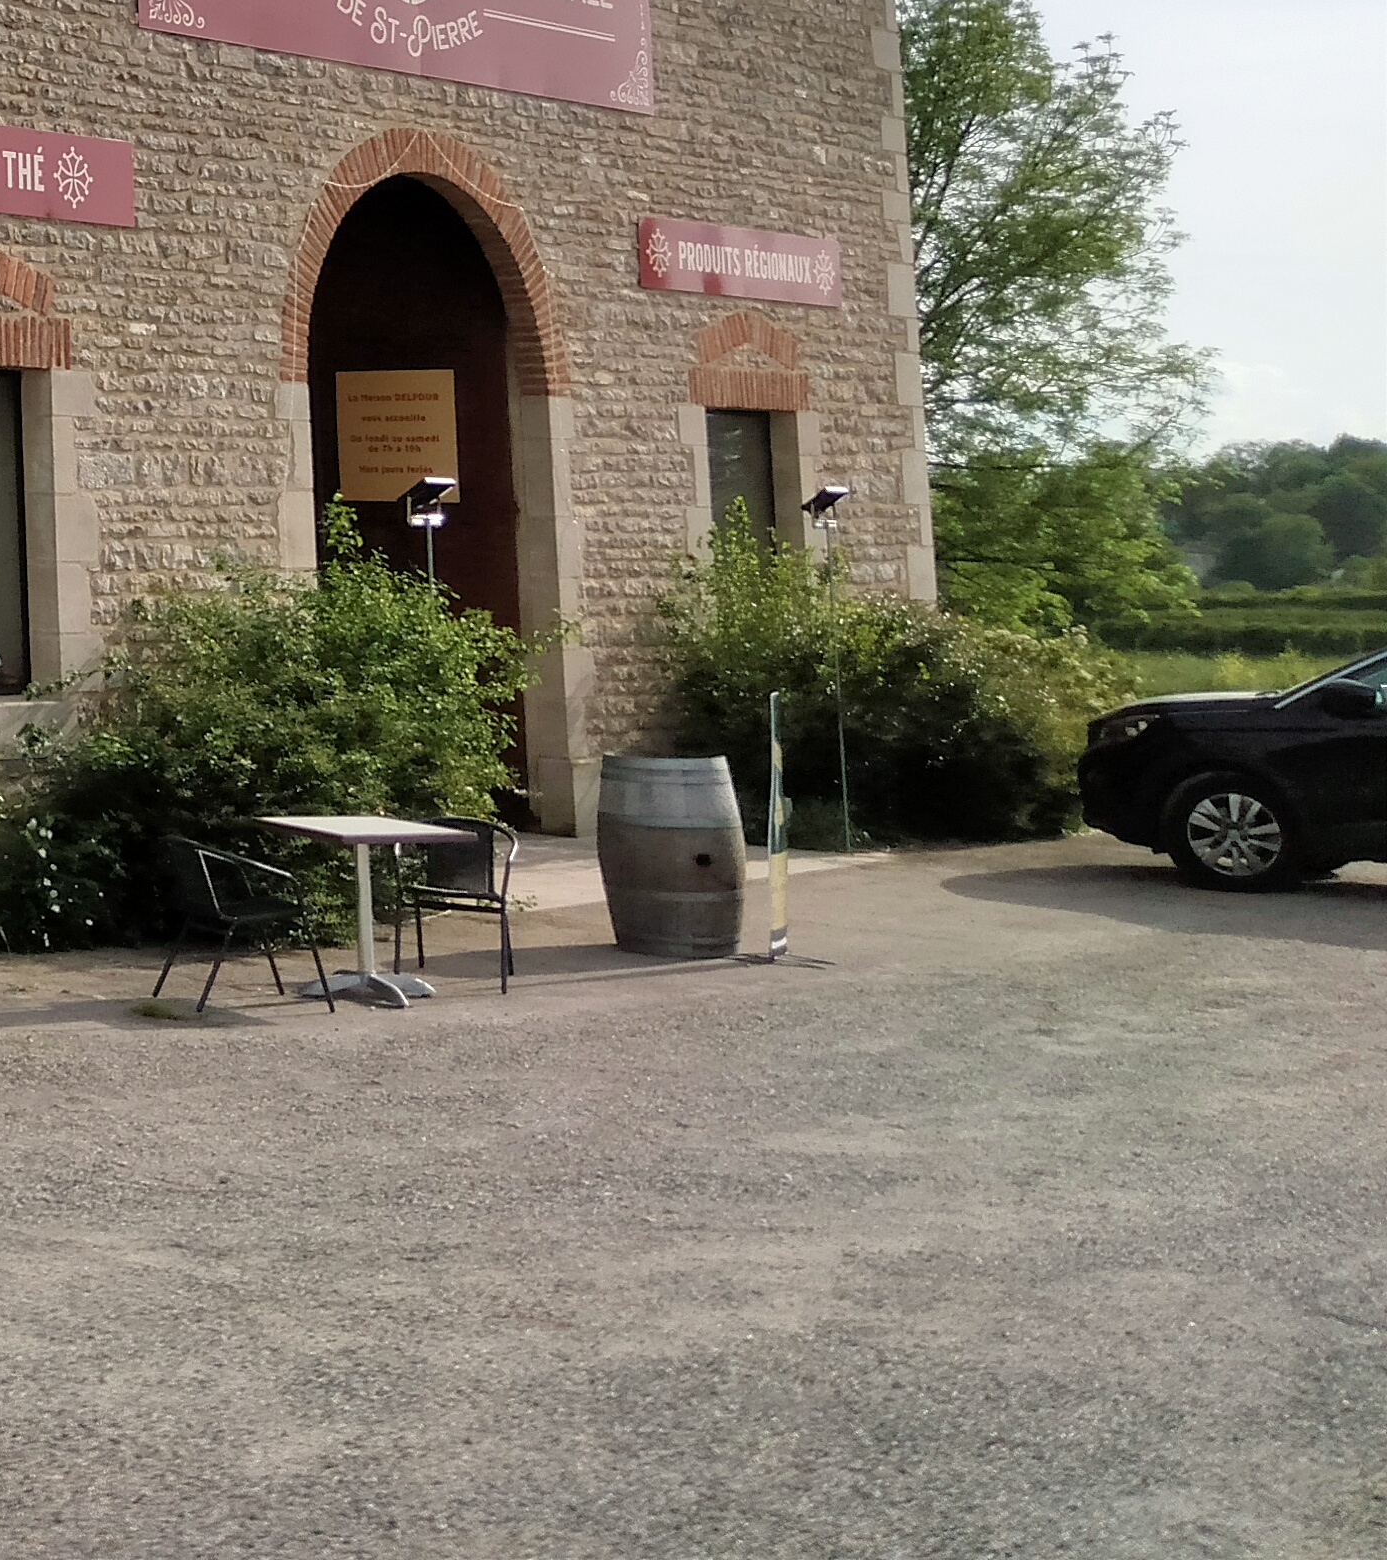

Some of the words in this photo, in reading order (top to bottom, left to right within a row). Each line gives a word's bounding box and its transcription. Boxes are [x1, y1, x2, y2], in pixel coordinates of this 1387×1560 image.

[2, 146, 45, 192] THÉ
[678, 241, 741, 276] PRODUITS
[744, 244, 812, 284] RÉGIONAUX
